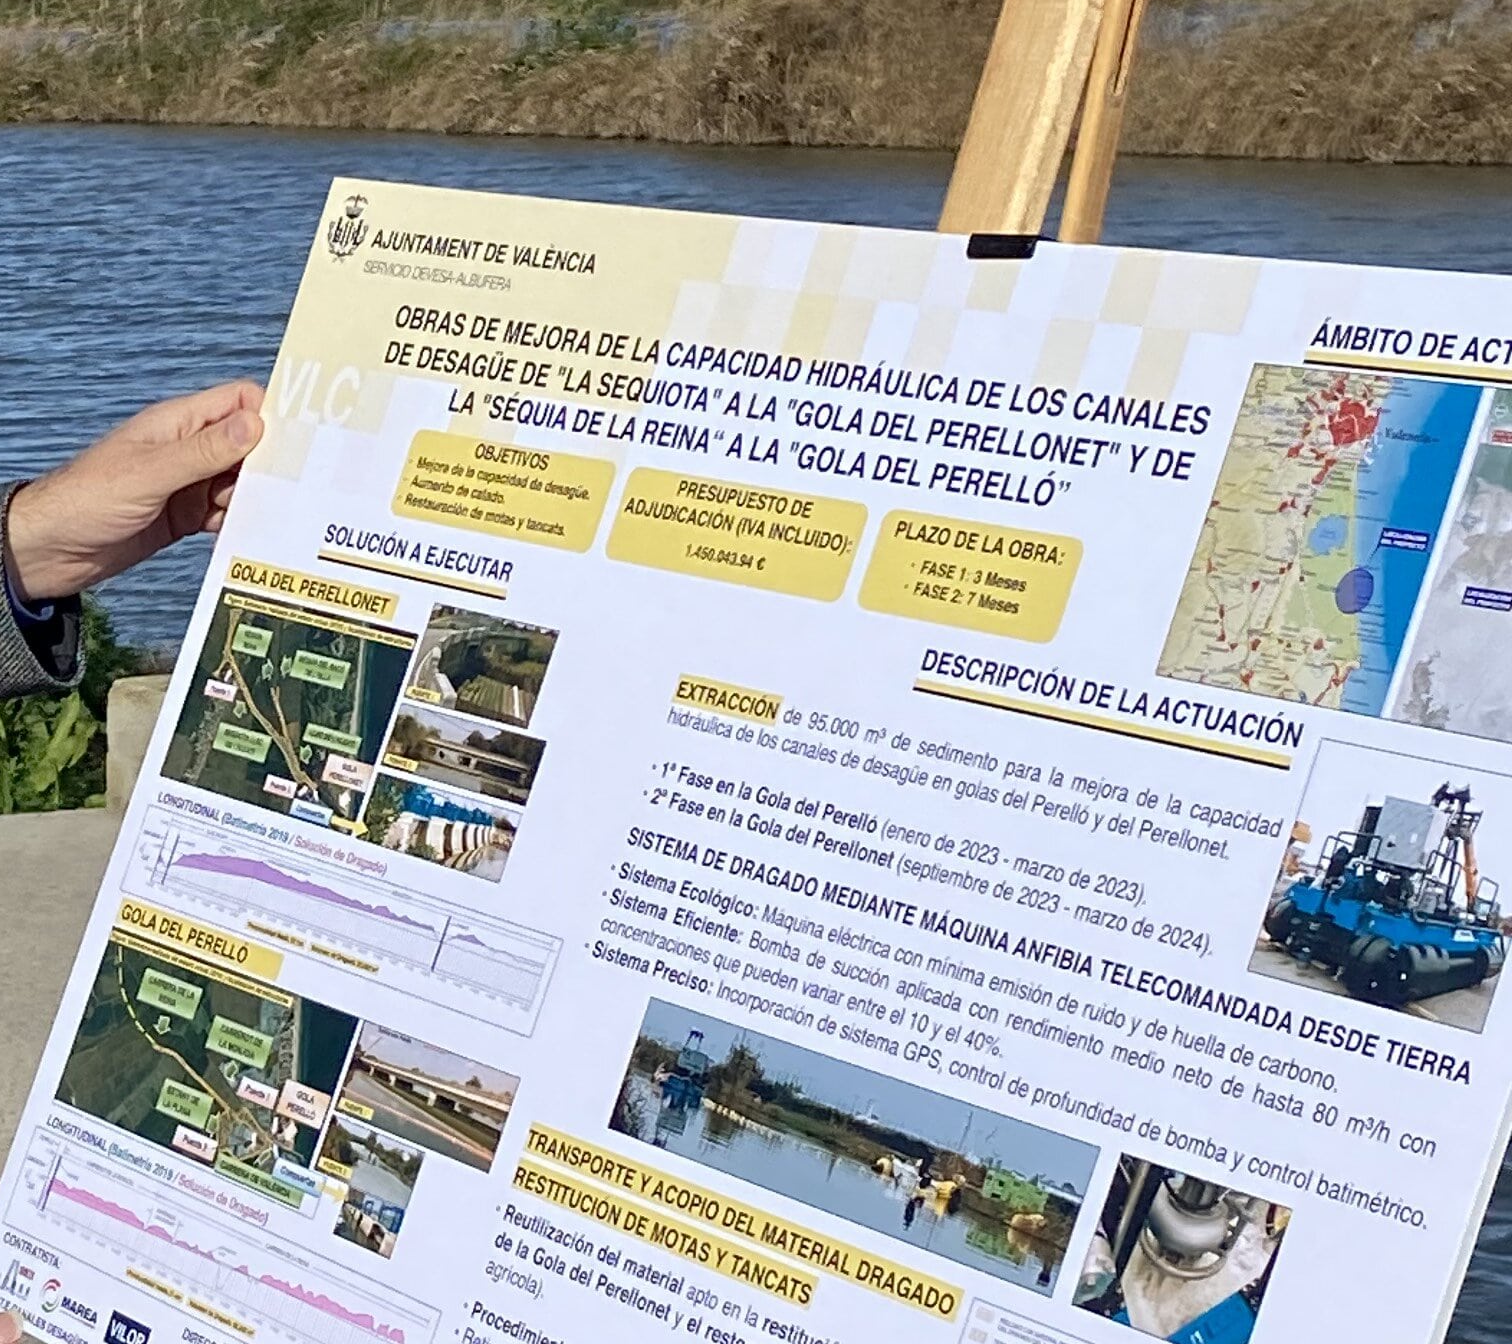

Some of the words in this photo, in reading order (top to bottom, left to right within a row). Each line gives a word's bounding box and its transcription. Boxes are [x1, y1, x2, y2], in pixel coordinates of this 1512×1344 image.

[370, 228, 484, 260] AJUNTAMENT
[482, 241, 509, 264] DE
[512, 244, 596, 274] VALÈNCIA
[1309, 316, 1413, 355] ÁMBITO
[1417, 332, 1458, 359] DE
[276, 359, 360, 423] VLC
[394, 304, 467, 337] OBRAS
[468, 314, 501, 341] DE
[502, 319, 591, 355] MEJORA
[594, 332, 630, 359] DE
[629, 336, 660, 364] LA
[665, 341, 802, 382] CAPACIDAD
[804, 359, 958, 404] HIDRÁULICA
[964, 378, 1006, 410] DE
[1008, 383, 1067, 417] LOS
[1072, 392, 1211, 435] CANALES
[383, 340, 415, 366] DE
[415, 345, 518, 382] DESAGÜE
[518, 360, 552, 388] DE
[722, 390, 740, 417] A
[745, 392, 777, 422] LA
[868, 410, 918, 443] DEL
[1129, 444, 1149, 473] Y
[1150, 447, 1196, 481] DE
[447, 388, 475, 415] LA
[571, 408, 605, 436] DE
[605, 413, 636, 442] LA
[724, 432, 742, 459] A
[747, 435, 779, 465] LA
[870, 454, 921, 487] DEL
[415, 455, 450, 474] Mejora
[450, 462, 465, 477] de
[464, 464, 475, 479] la
[475, 469, 530, 489] capacidad
[528, 477, 543, 492] de
[543, 480, 590, 500] desagüe.
[473, 442, 550, 471] OBJETIVOS
[403, 492, 469, 517] Restauración
[469, 505, 484, 520] de
[483, 511, 516, 527] motas
[515, 517, 525, 531] y
[525, 517, 565, 537] tancats.
[409, 474, 455, 495] Aumento
[454, 484, 470, 498] de
[469, 488, 505, 504] calado.
[675, 479, 788, 515] PRESUPUESTO
[788, 499, 814, 519] DE
[323, 523, 409, 559] SOLUCIÓN
[408, 542, 421, 563] A
[423, 544, 513, 582] EJECUTAR
[623, 497, 735, 532] ADJUDICACIÓN
[735, 516, 765, 538] (IVA
[766, 522, 853, 556] INCLUIDO):
[893, 520, 951, 546] PLAZO
[952, 530, 980, 551] DE
[980, 534, 1004, 556] LA
[1007, 539, 1065, 566] OBRA:
[230, 562, 268, 586] GOLA
[269, 571, 295, 593] DEL
[298, 578, 391, 614] PERELLONET
[912, 580, 951, 602] FASE
[949, 588, 965, 604] 2:
[966, 590, 977, 606] 7
[976, 593, 1020, 614] Meses
[919, 559, 957, 580] FASE
[972, 569, 983, 585] 3
[983, 570, 1027, 593] Meses
[920, 648, 1076, 701] DESCRIPCIÓN
[1078, 680, 1115, 709] DE
[1116, 688, 1148, 717] LA
[1151, 696, 1304, 748] ACTUACIÓN
[675, 679, 780, 720] EXTRACCIÓN
[782, 708, 802, 726] de
[807, 711, 860, 739] 95.000
[890, 731, 911, 752] de
[916, 740, 998, 772] sedimento
[1001, 760, 1042, 783] para
[1047, 766, 1064, 788] la
[1070, 776, 1129, 803] mejora
[1135, 787, 1159, 809] de
[1164, 793, 1182, 815] la
[1189, 803, 1284, 838] capacidad
[676, 765, 714, 791] Fase
[714, 779, 735, 797] en
[736, 780, 753, 801] la
[755, 785, 791, 811] Gola
[793, 796, 821, 818] del
[820, 802, 878, 834] Perelló
[880, 818, 931, 848] (enero
[933, 834, 955, 854] de
[956, 838, 1000, 866] 2023
[1012, 857, 1065, 883] marzo
[1067, 868, 1091, 890] de
[1092, 873, 1146, 908] 2023).
[120, 903, 157, 931] GOLA
[158, 916, 183, 941] DEL
[185, 926, 249, 964] PERELLÓ
[626, 826, 698, 864] SISTEMA
[700, 847, 728, 871] DE
[728, 855, 819, 897] DRAGADO
[820, 881, 918, 926] MEDIANTE
[918, 908, 1009, 953] MÁQUINA
[1011, 936, 1092, 977] ANFIBIA
[1100, 958, 1292, 1035] TELECOMANDADA
[1297, 1015, 1380, 1058] DESDE
[1385, 1038, 1470, 1085] TIERRA
[512, 1165, 622, 1226] RESTITUCIÓN
[622, 1210, 650, 1238] DE
[649, 1221, 711, 1263] MOTAS
[715, 1247, 729, 1268] Y
[730, 1254, 812, 1305] TANCATS
[527, 1128, 637, 1189] TRANSPORTE
[640, 1172, 653, 1193] Y
[650, 1179, 720, 1221] ACOPIO
[720, 1206, 755, 1238] DEL
[759, 1221, 850, 1276] MATERIAL
[854, 1259, 955, 1315] DRAGADO
[60, 1296, 98, 1324] MAREA
